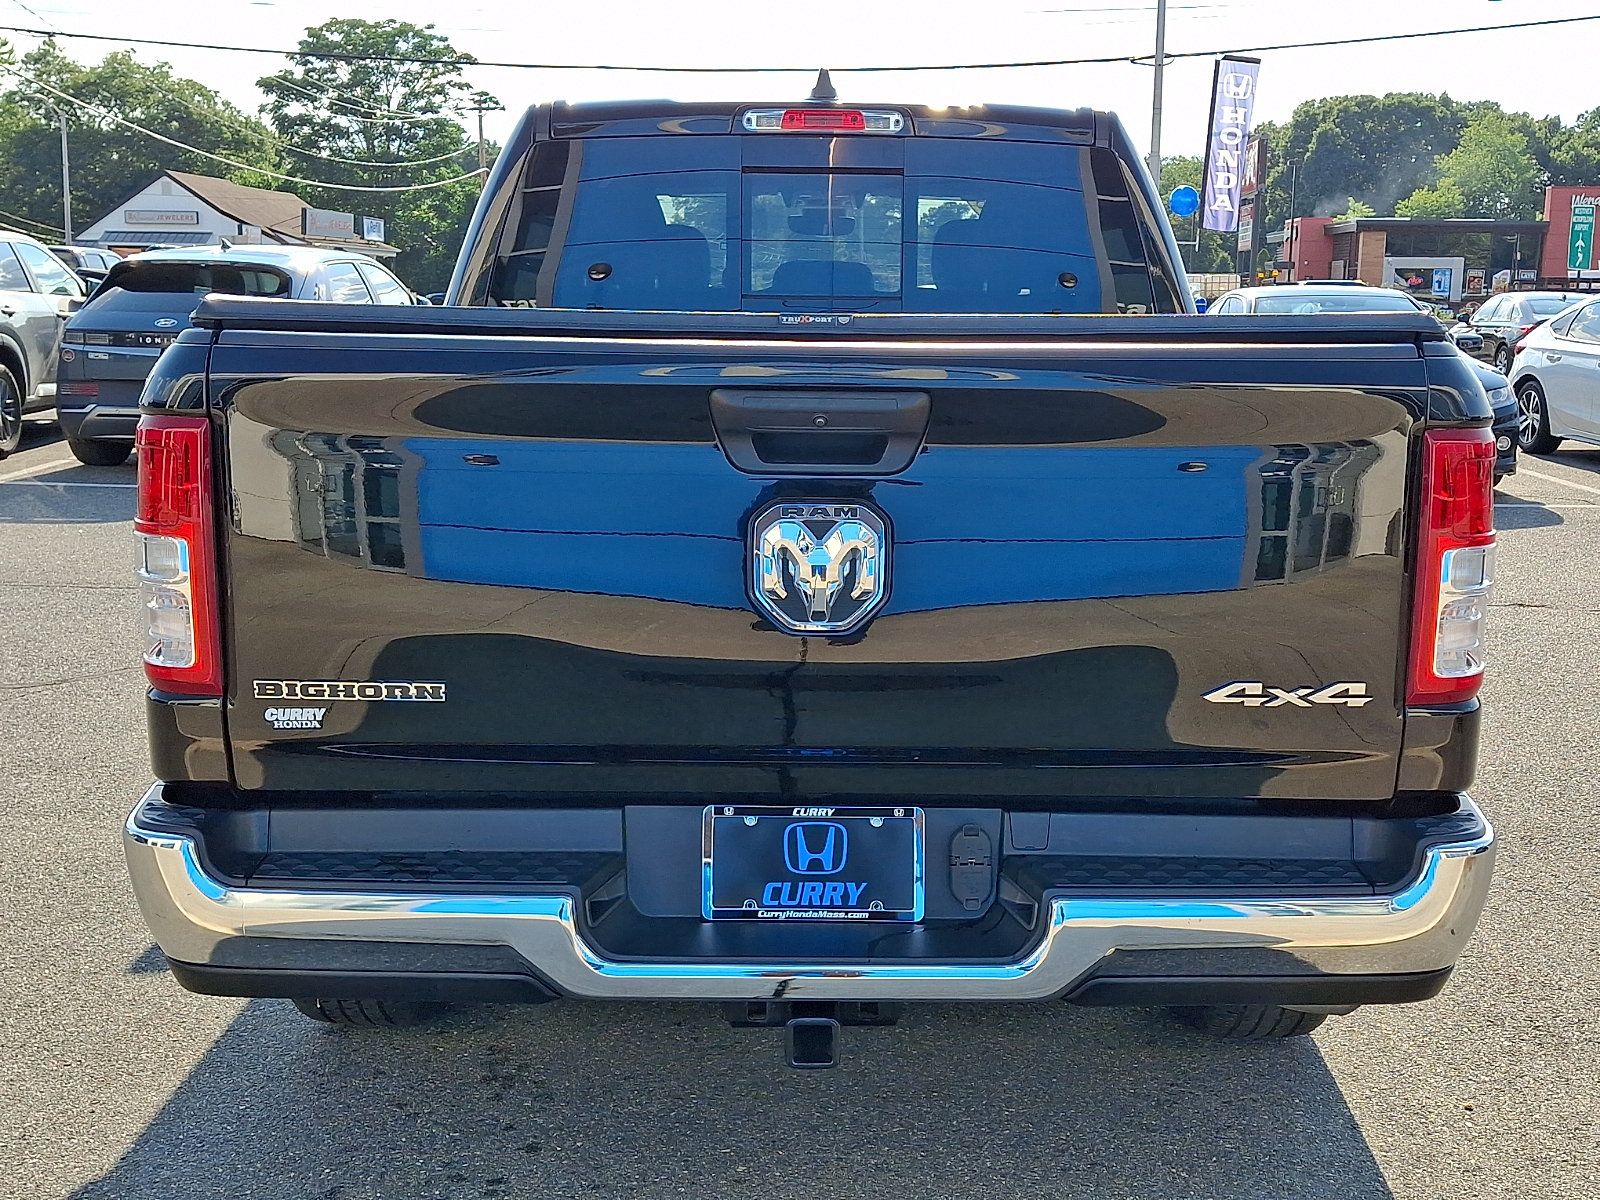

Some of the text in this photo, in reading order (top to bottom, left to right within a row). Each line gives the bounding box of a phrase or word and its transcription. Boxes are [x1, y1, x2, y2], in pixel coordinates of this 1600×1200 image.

[1210, 106, 1249, 212] HONDA
[781, 507, 859, 519] RAM
[253, 680, 447, 702] BIGHORN
[1201, 681, 1374, 707] 4x4
[264, 707, 327, 722] CURRY
[272, 720, 322, 729] HONDA
[792, 807, 836, 817] CURRY
[762, 882, 868, 906] CURRY
[757, 909, 869, 920] CurryHondaMass.com
